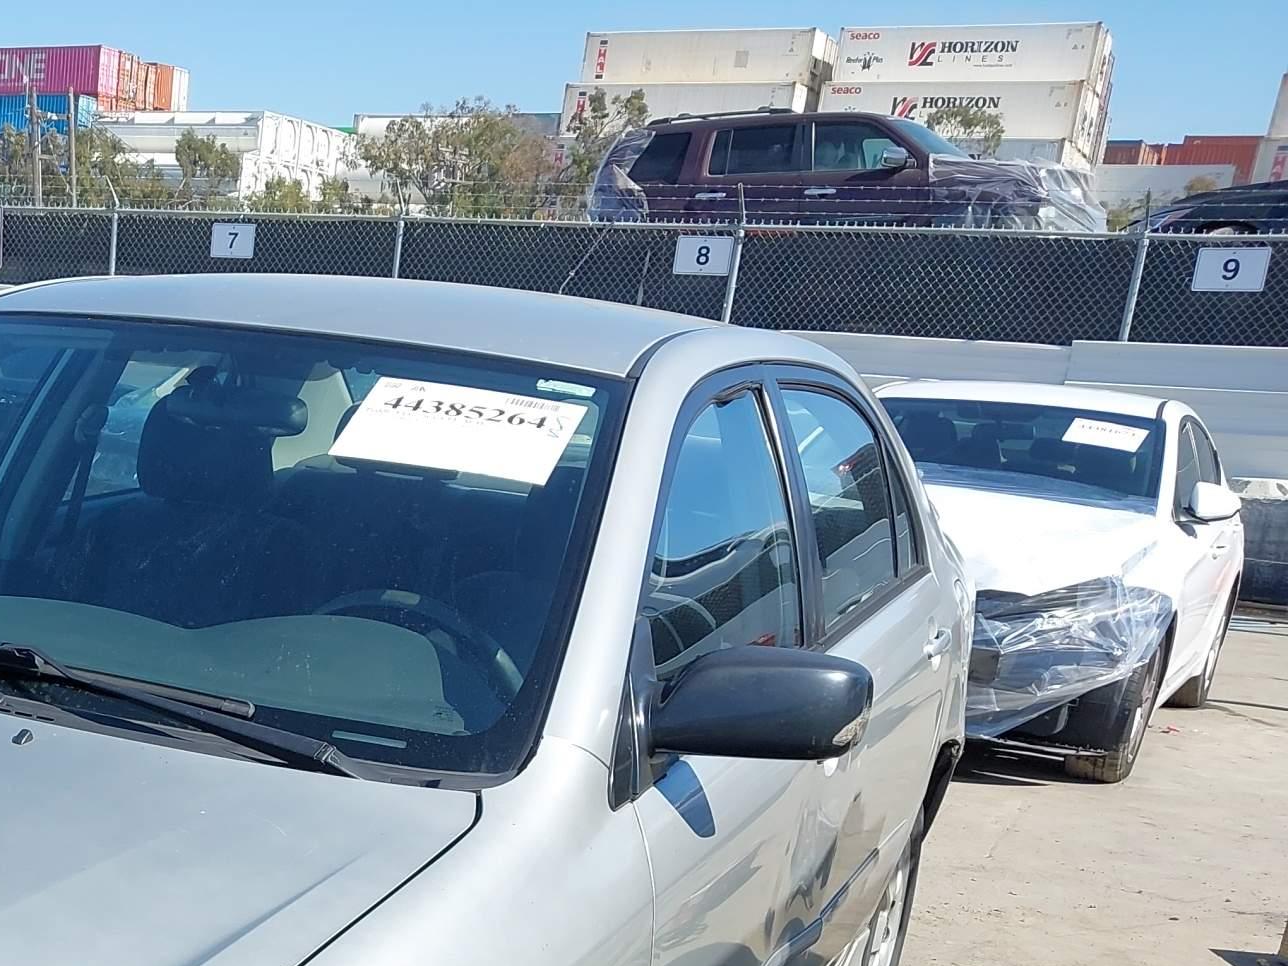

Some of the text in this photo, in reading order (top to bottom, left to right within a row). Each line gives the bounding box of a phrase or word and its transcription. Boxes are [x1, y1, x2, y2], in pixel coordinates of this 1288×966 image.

[850, 32, 881, 40] seaco
[939, 40, 1021, 54] HORIZON
[831, 85, 862, 95] seaco
[921, 96, 1001, 109] HORIZON
[228, 231, 240, 249] 7
[696, 245, 711, 266] 8
[1222, 258, 1241, 281] 9
[383, 395, 547, 429] 44385264
